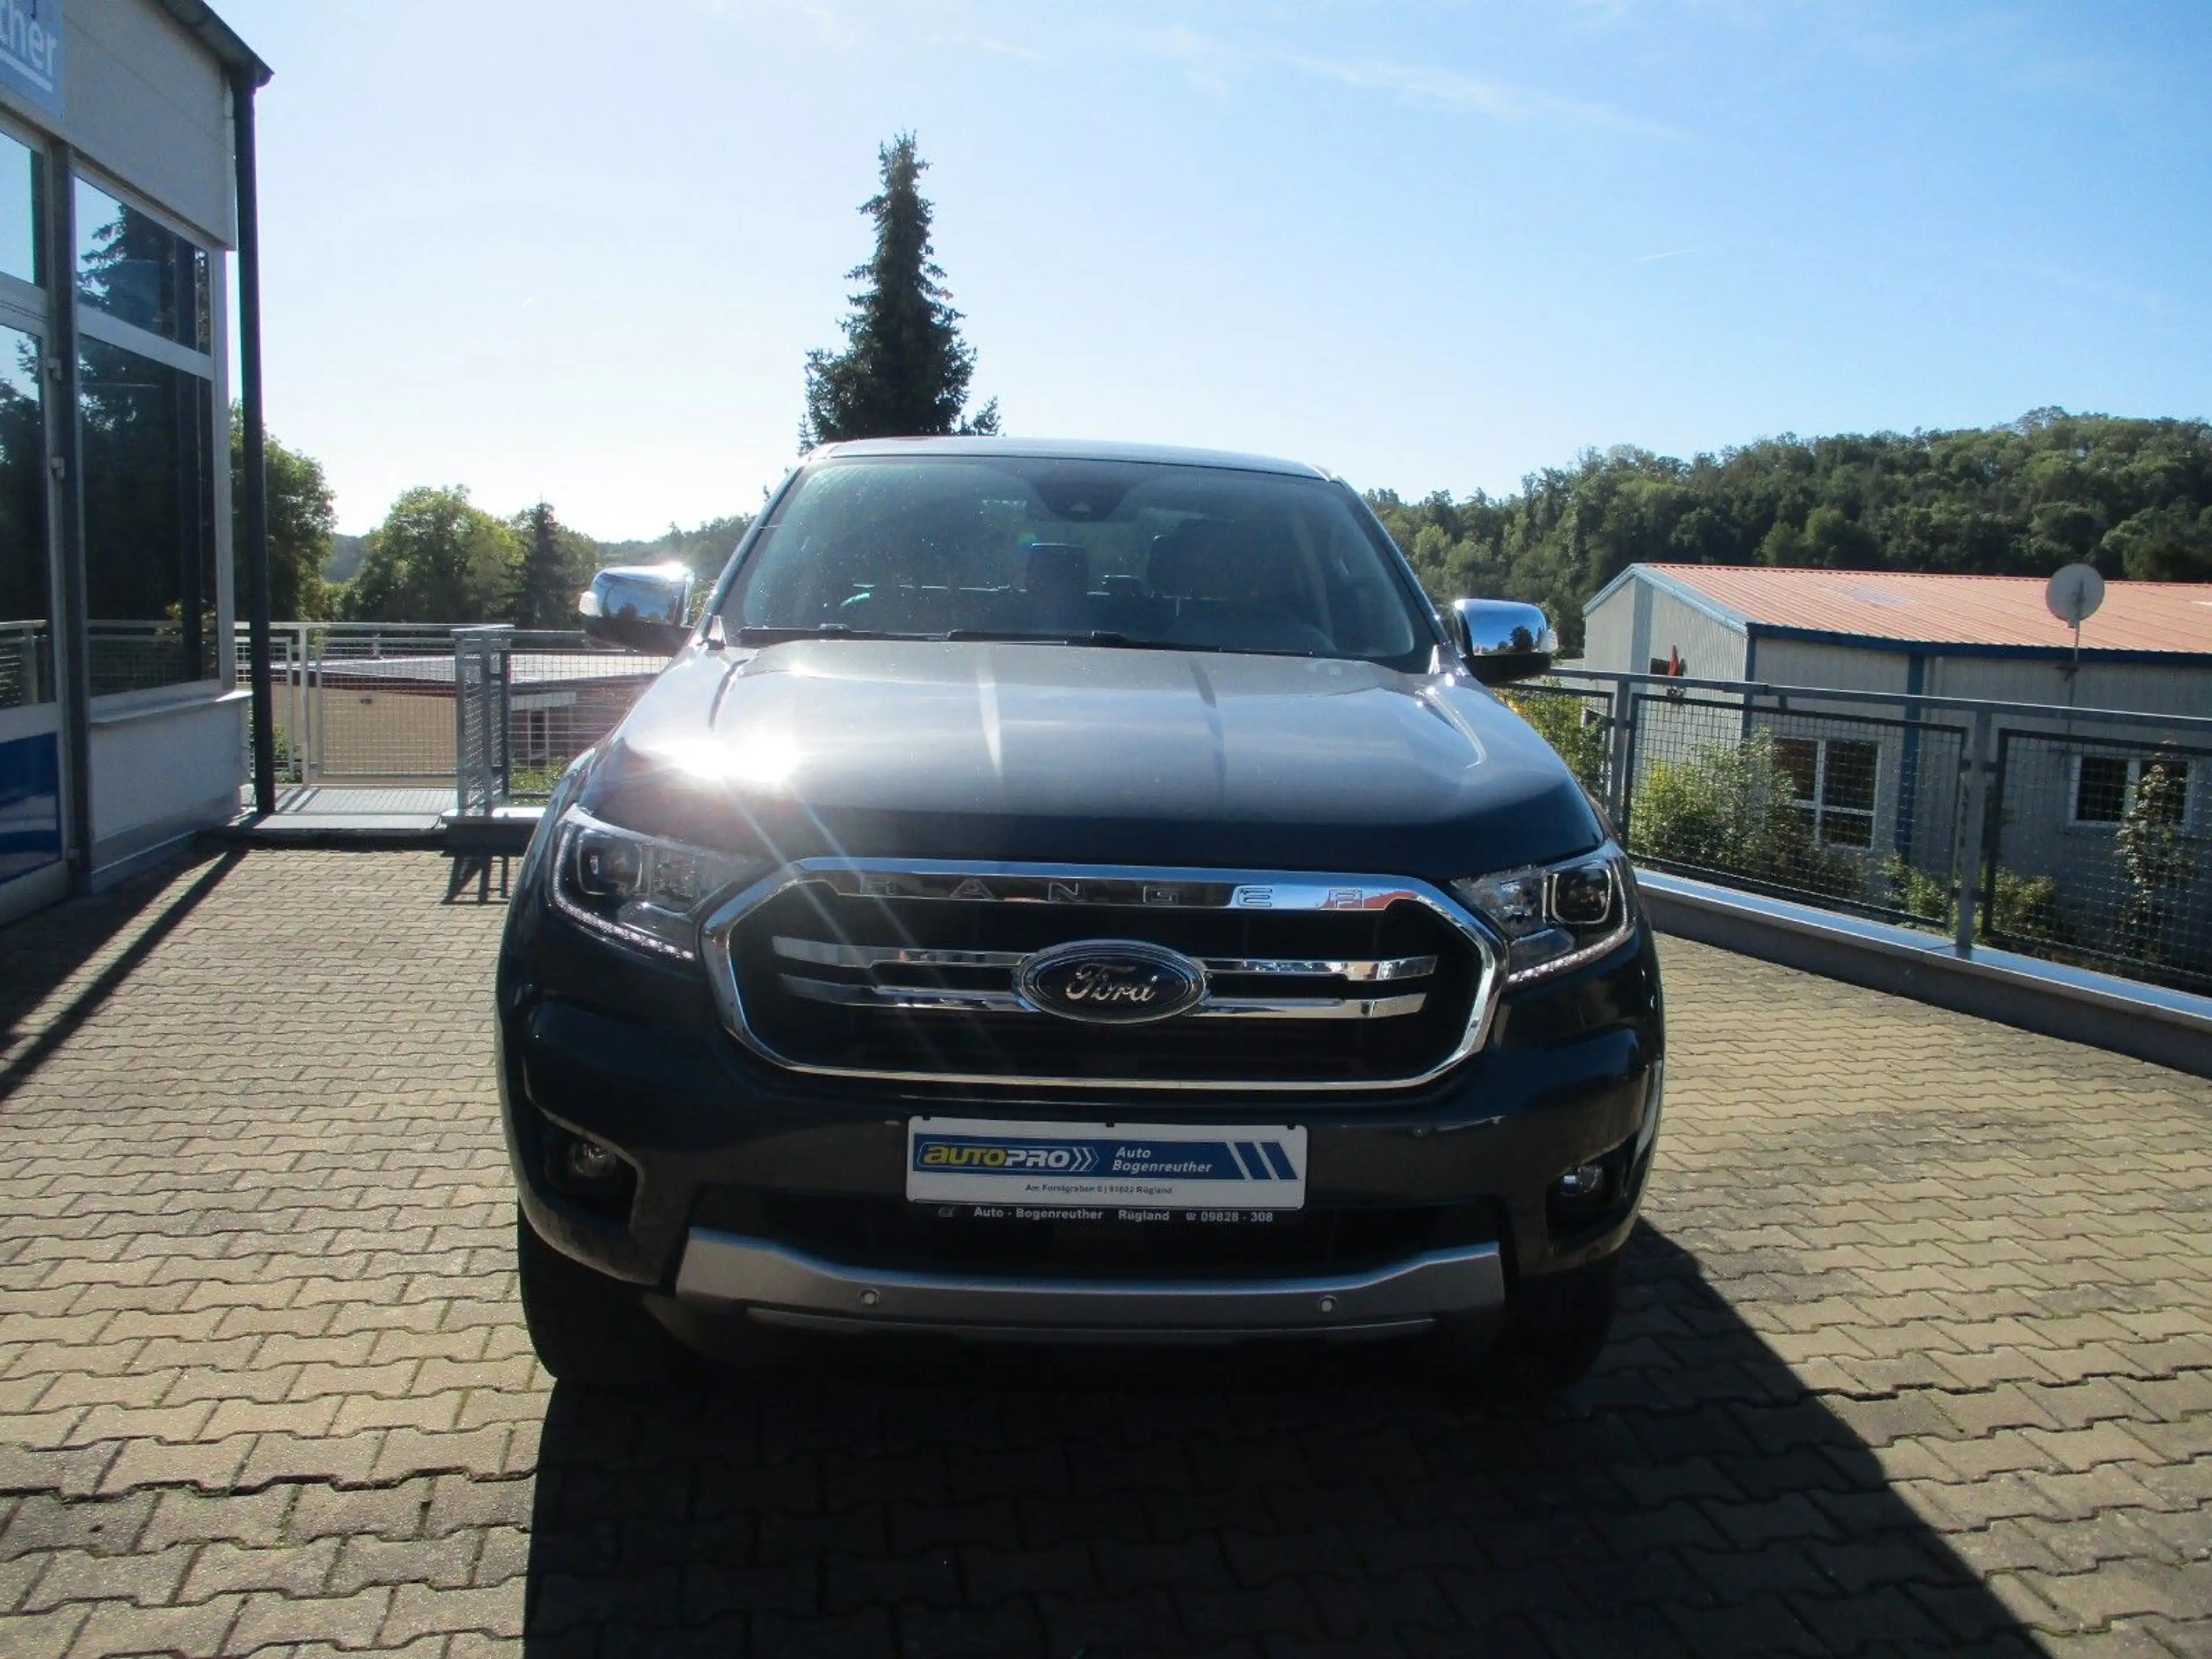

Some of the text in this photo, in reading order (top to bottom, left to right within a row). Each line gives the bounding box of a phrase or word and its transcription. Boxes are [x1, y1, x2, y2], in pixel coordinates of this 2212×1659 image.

[860, 875, 1363, 909] RANGER
[1066, 963, 1158, 1001] Ford
[1115, 1146, 1152, 1158] Auto
[1112, 1159, 1213, 1175] Bogenreuther
[1135, 1185, 1172, 1195] Rügland
[974, 1207, 1003, 1218] Auto
[1016, 1208, 1104, 1220] Bogenreuther
[1118, 1210, 1170, 1222] Rügland
[1200, 1211, 1238, 1222] 09828
[1251, 1211, 1273, 1222] 308
